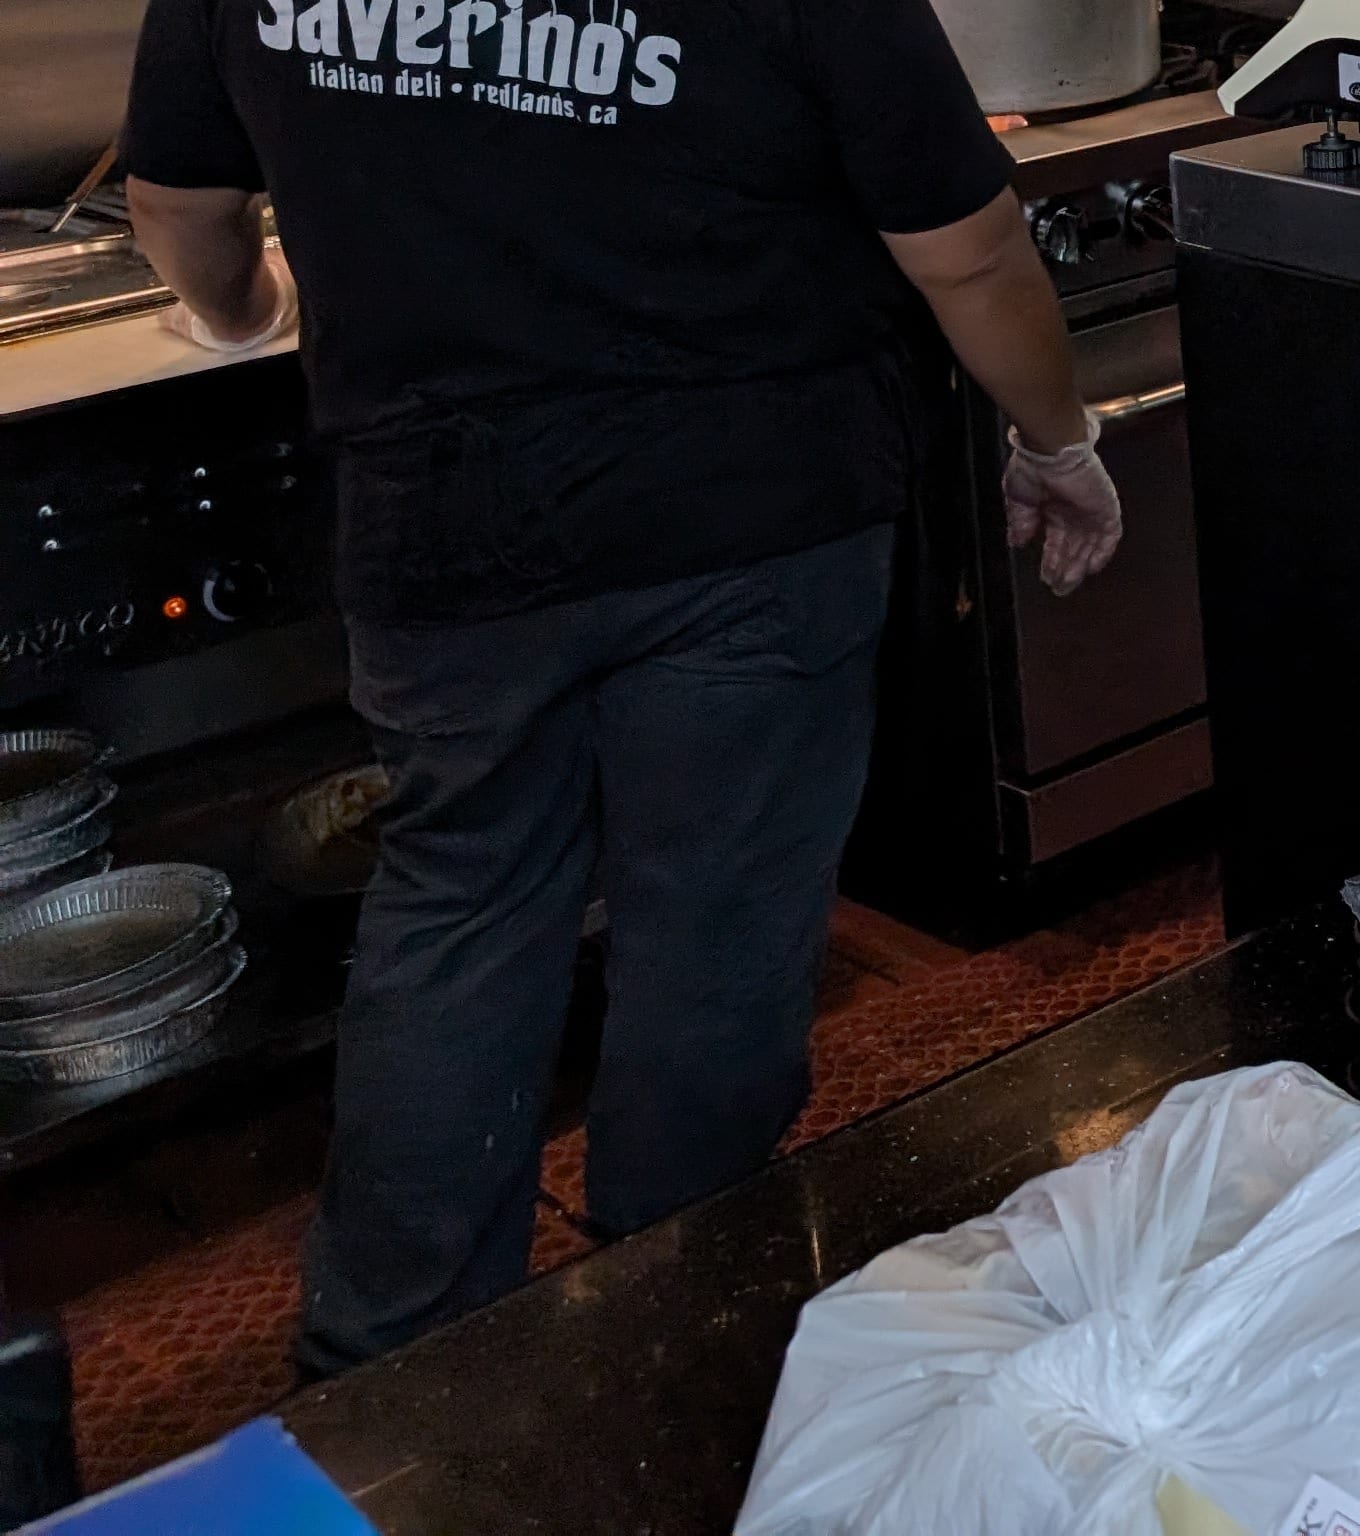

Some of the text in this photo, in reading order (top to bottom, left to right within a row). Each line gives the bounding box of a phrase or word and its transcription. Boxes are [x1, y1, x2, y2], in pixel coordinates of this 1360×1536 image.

[310, 62, 384, 96] italian
[396, 70, 441, 99] deli
[589, 104, 618, 126] ca
